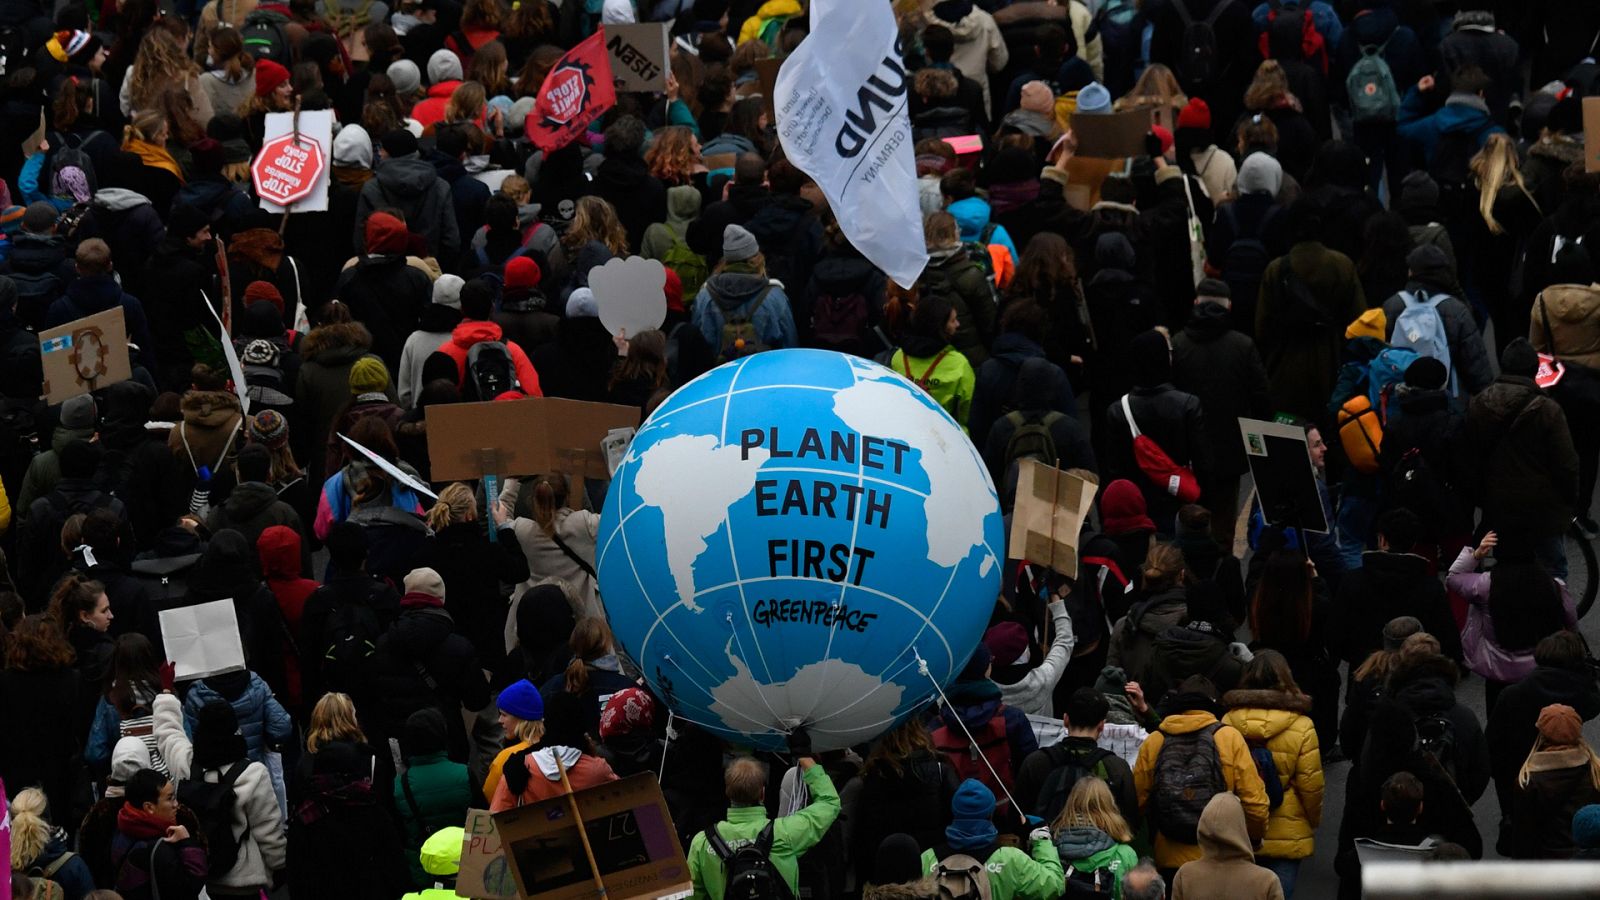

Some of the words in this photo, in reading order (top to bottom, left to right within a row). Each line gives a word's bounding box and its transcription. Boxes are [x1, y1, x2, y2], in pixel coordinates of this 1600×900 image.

[274, 155, 305, 174] STOP
[262, 178, 292, 197] STOP
[741, 427, 910, 474] PLANET
[755, 480, 892, 529] EARTH
[768, 539, 875, 586] FIRST
[753, 599, 878, 633] GREENPEACE
